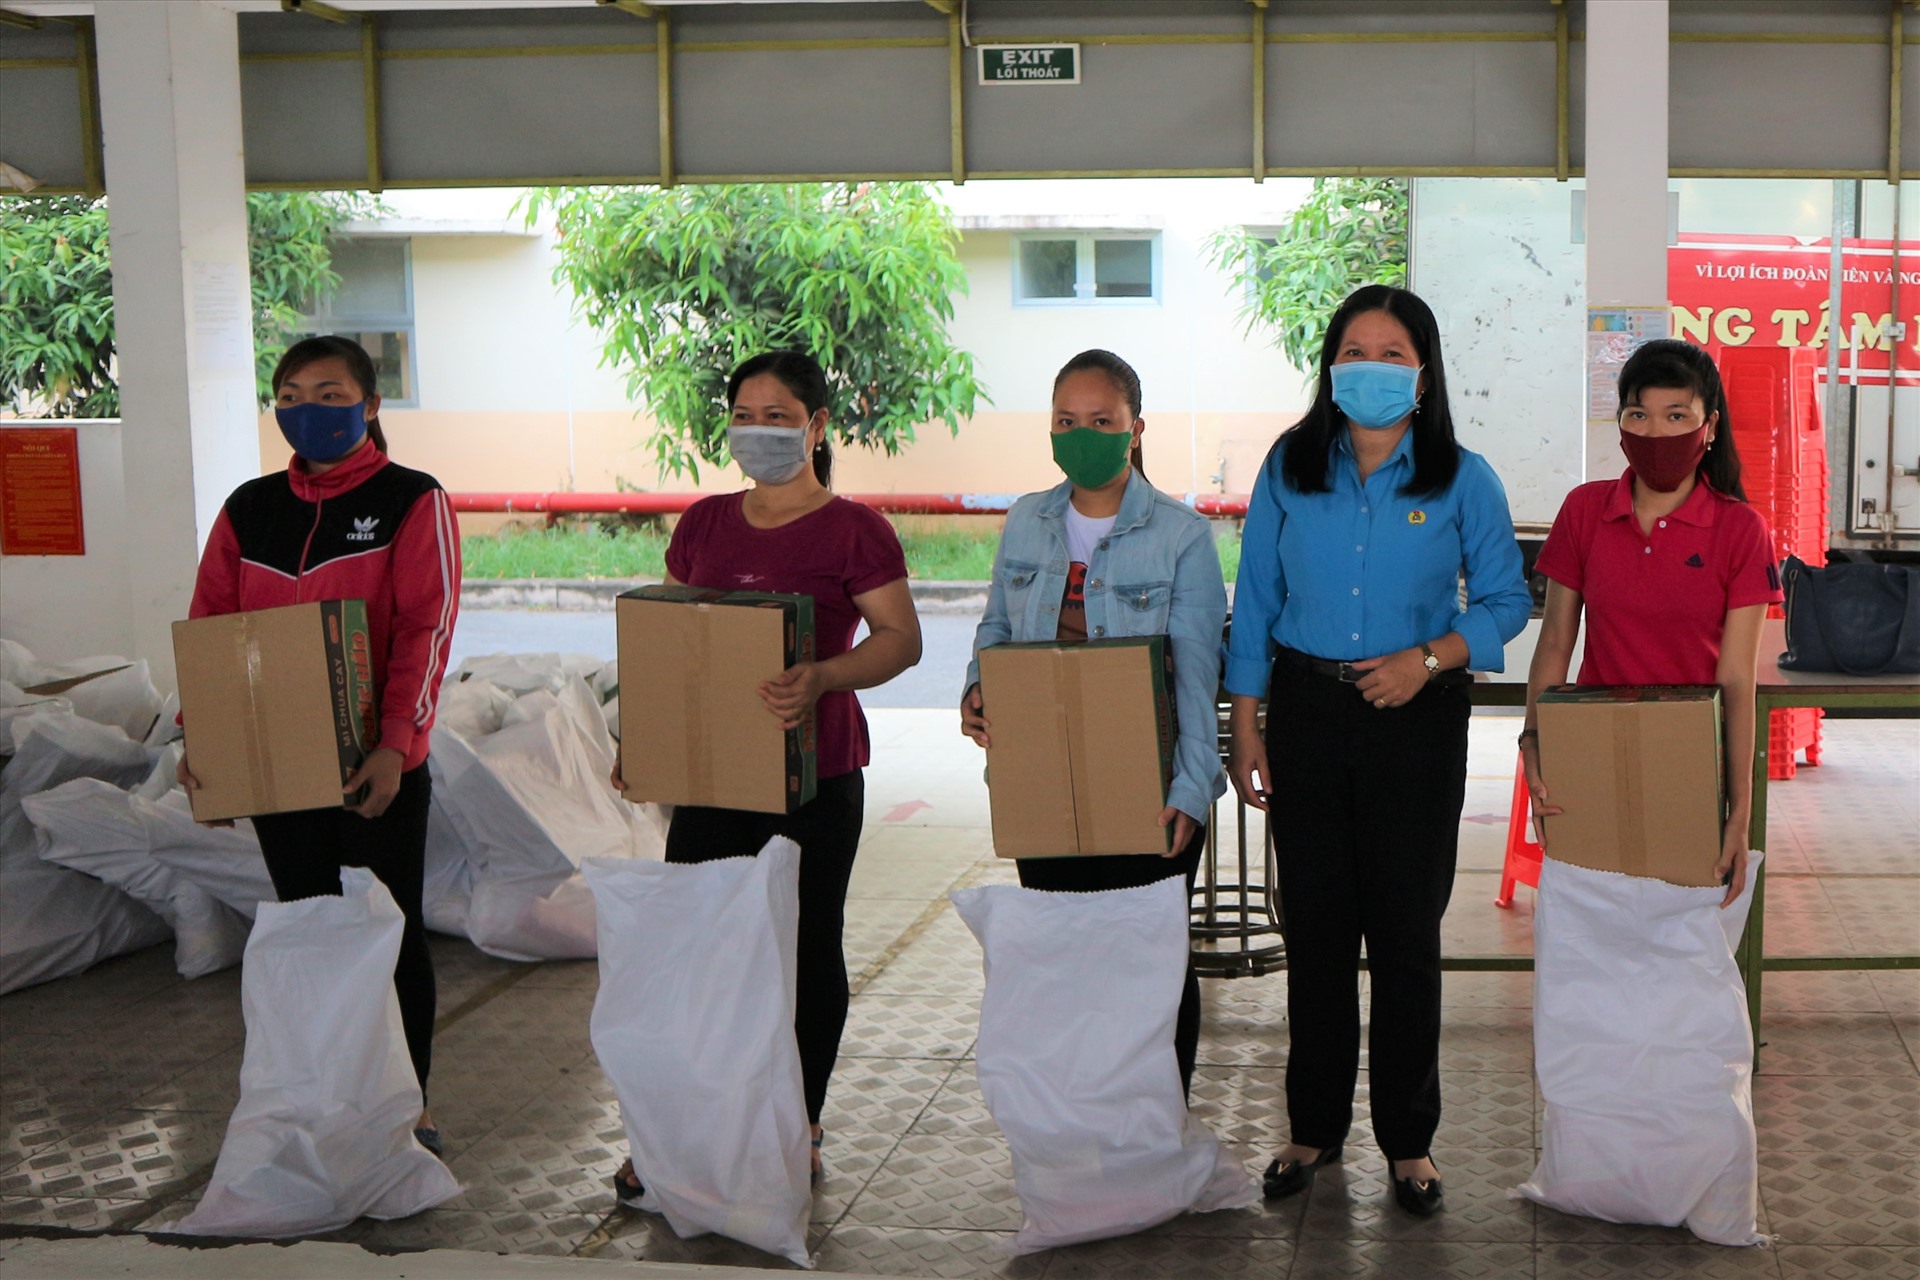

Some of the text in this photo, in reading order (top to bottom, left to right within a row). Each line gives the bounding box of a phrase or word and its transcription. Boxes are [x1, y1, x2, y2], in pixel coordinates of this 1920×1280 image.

[1002, 50, 1054, 64] EXIT
[1021, 65, 1061, 78] THOÁT
[1696, 262, 1920, 284] VÌ LỢI ÍCH ĐOÀN IÊN VÀ NG
[1671, 306, 1755, 346] NG
[334, 658, 344, 685] CAY
[338, 689, 348, 727] CHUA
